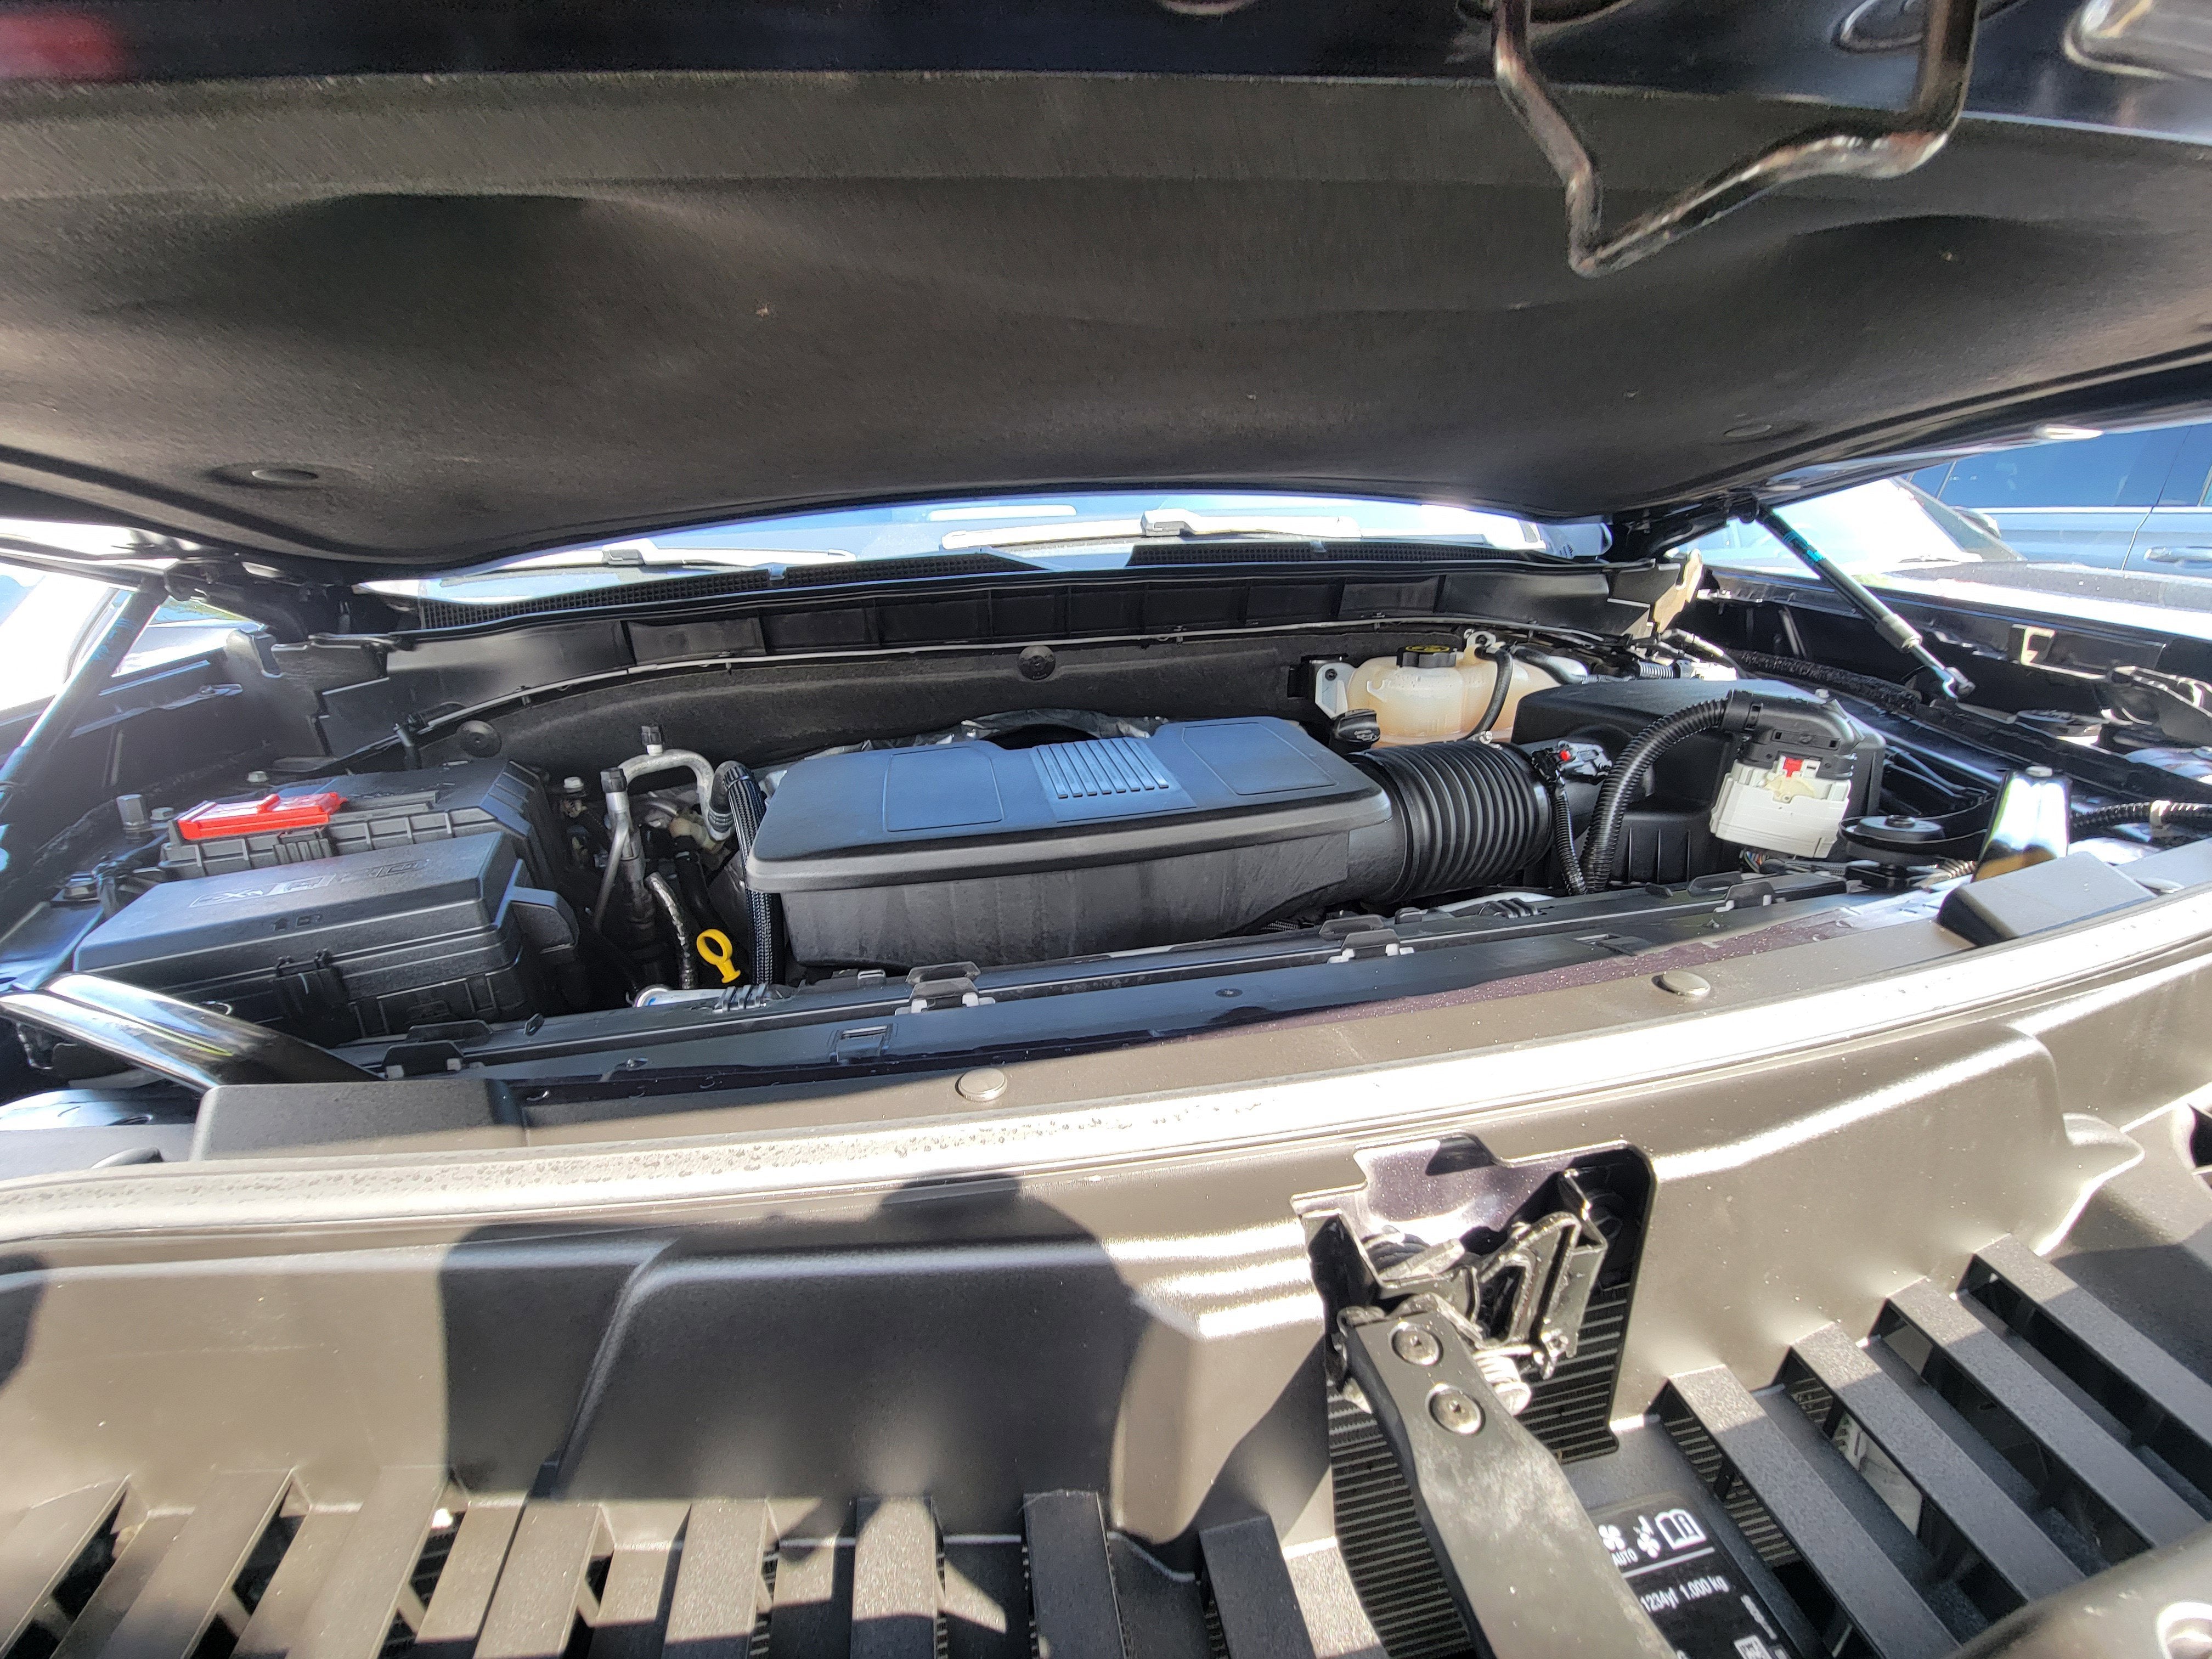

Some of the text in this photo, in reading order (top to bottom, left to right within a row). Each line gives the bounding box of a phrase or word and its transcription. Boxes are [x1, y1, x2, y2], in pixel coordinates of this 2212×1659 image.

[1612, 1548, 1638, 1566] AUTO
[1679, 1577, 1712, 1601] 1.000
[1707, 1575, 1730, 1593] kg
